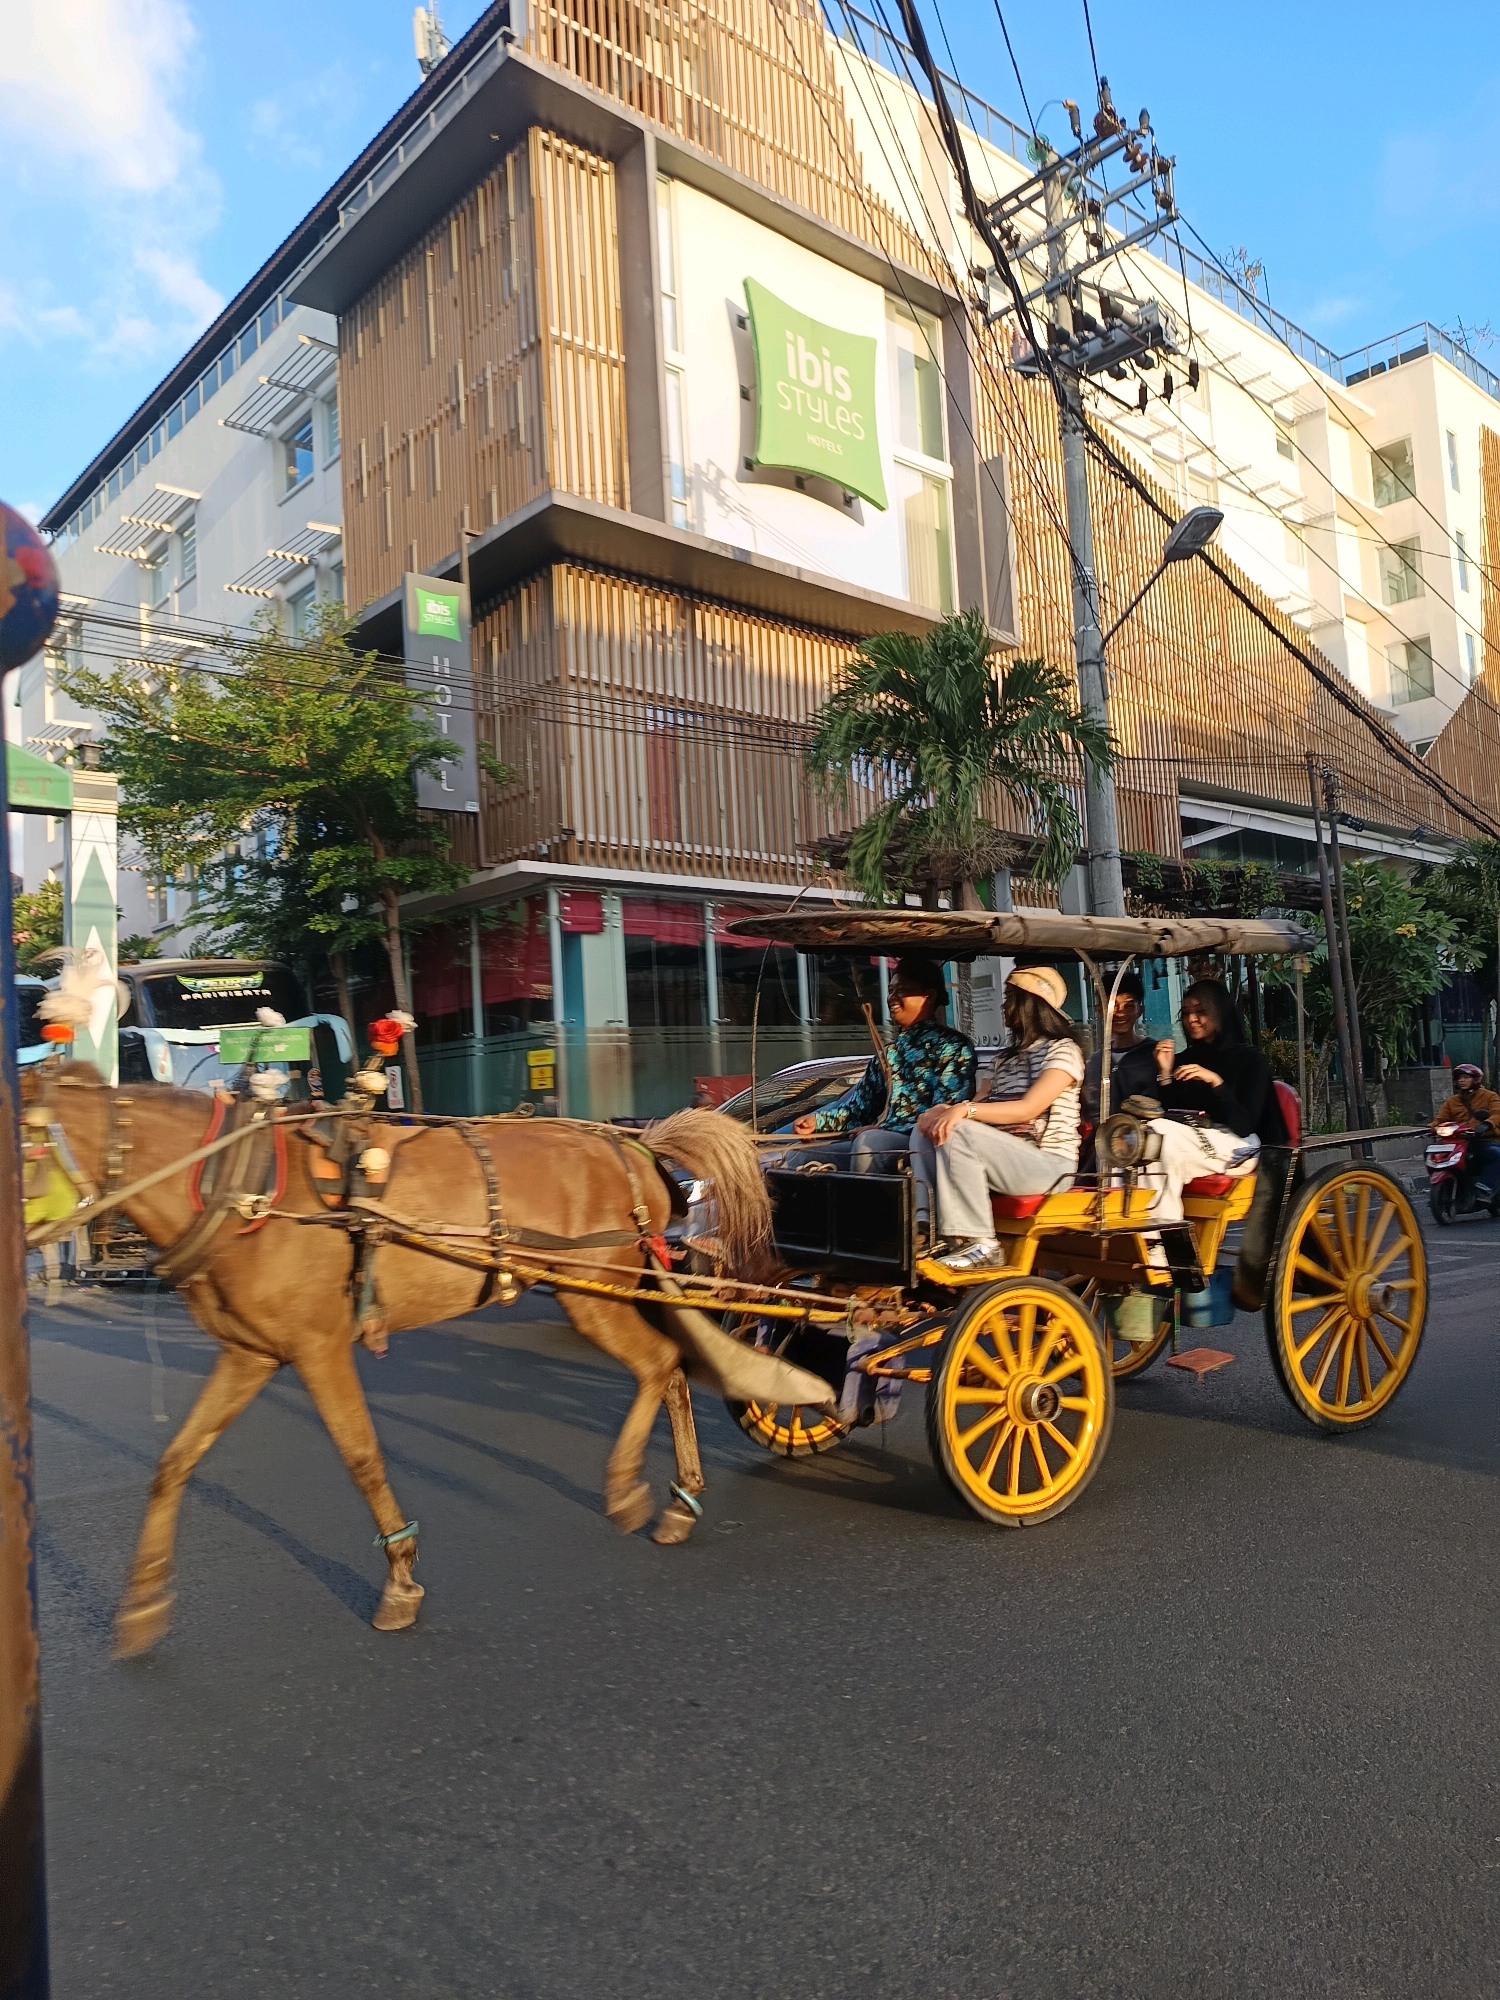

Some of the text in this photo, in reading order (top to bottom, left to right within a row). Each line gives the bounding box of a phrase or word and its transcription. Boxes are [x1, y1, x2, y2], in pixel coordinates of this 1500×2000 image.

[784, 330, 853, 402] ibis
[806, 432, 843, 455] HOTELS
[425, 599, 451, 616] ibis
